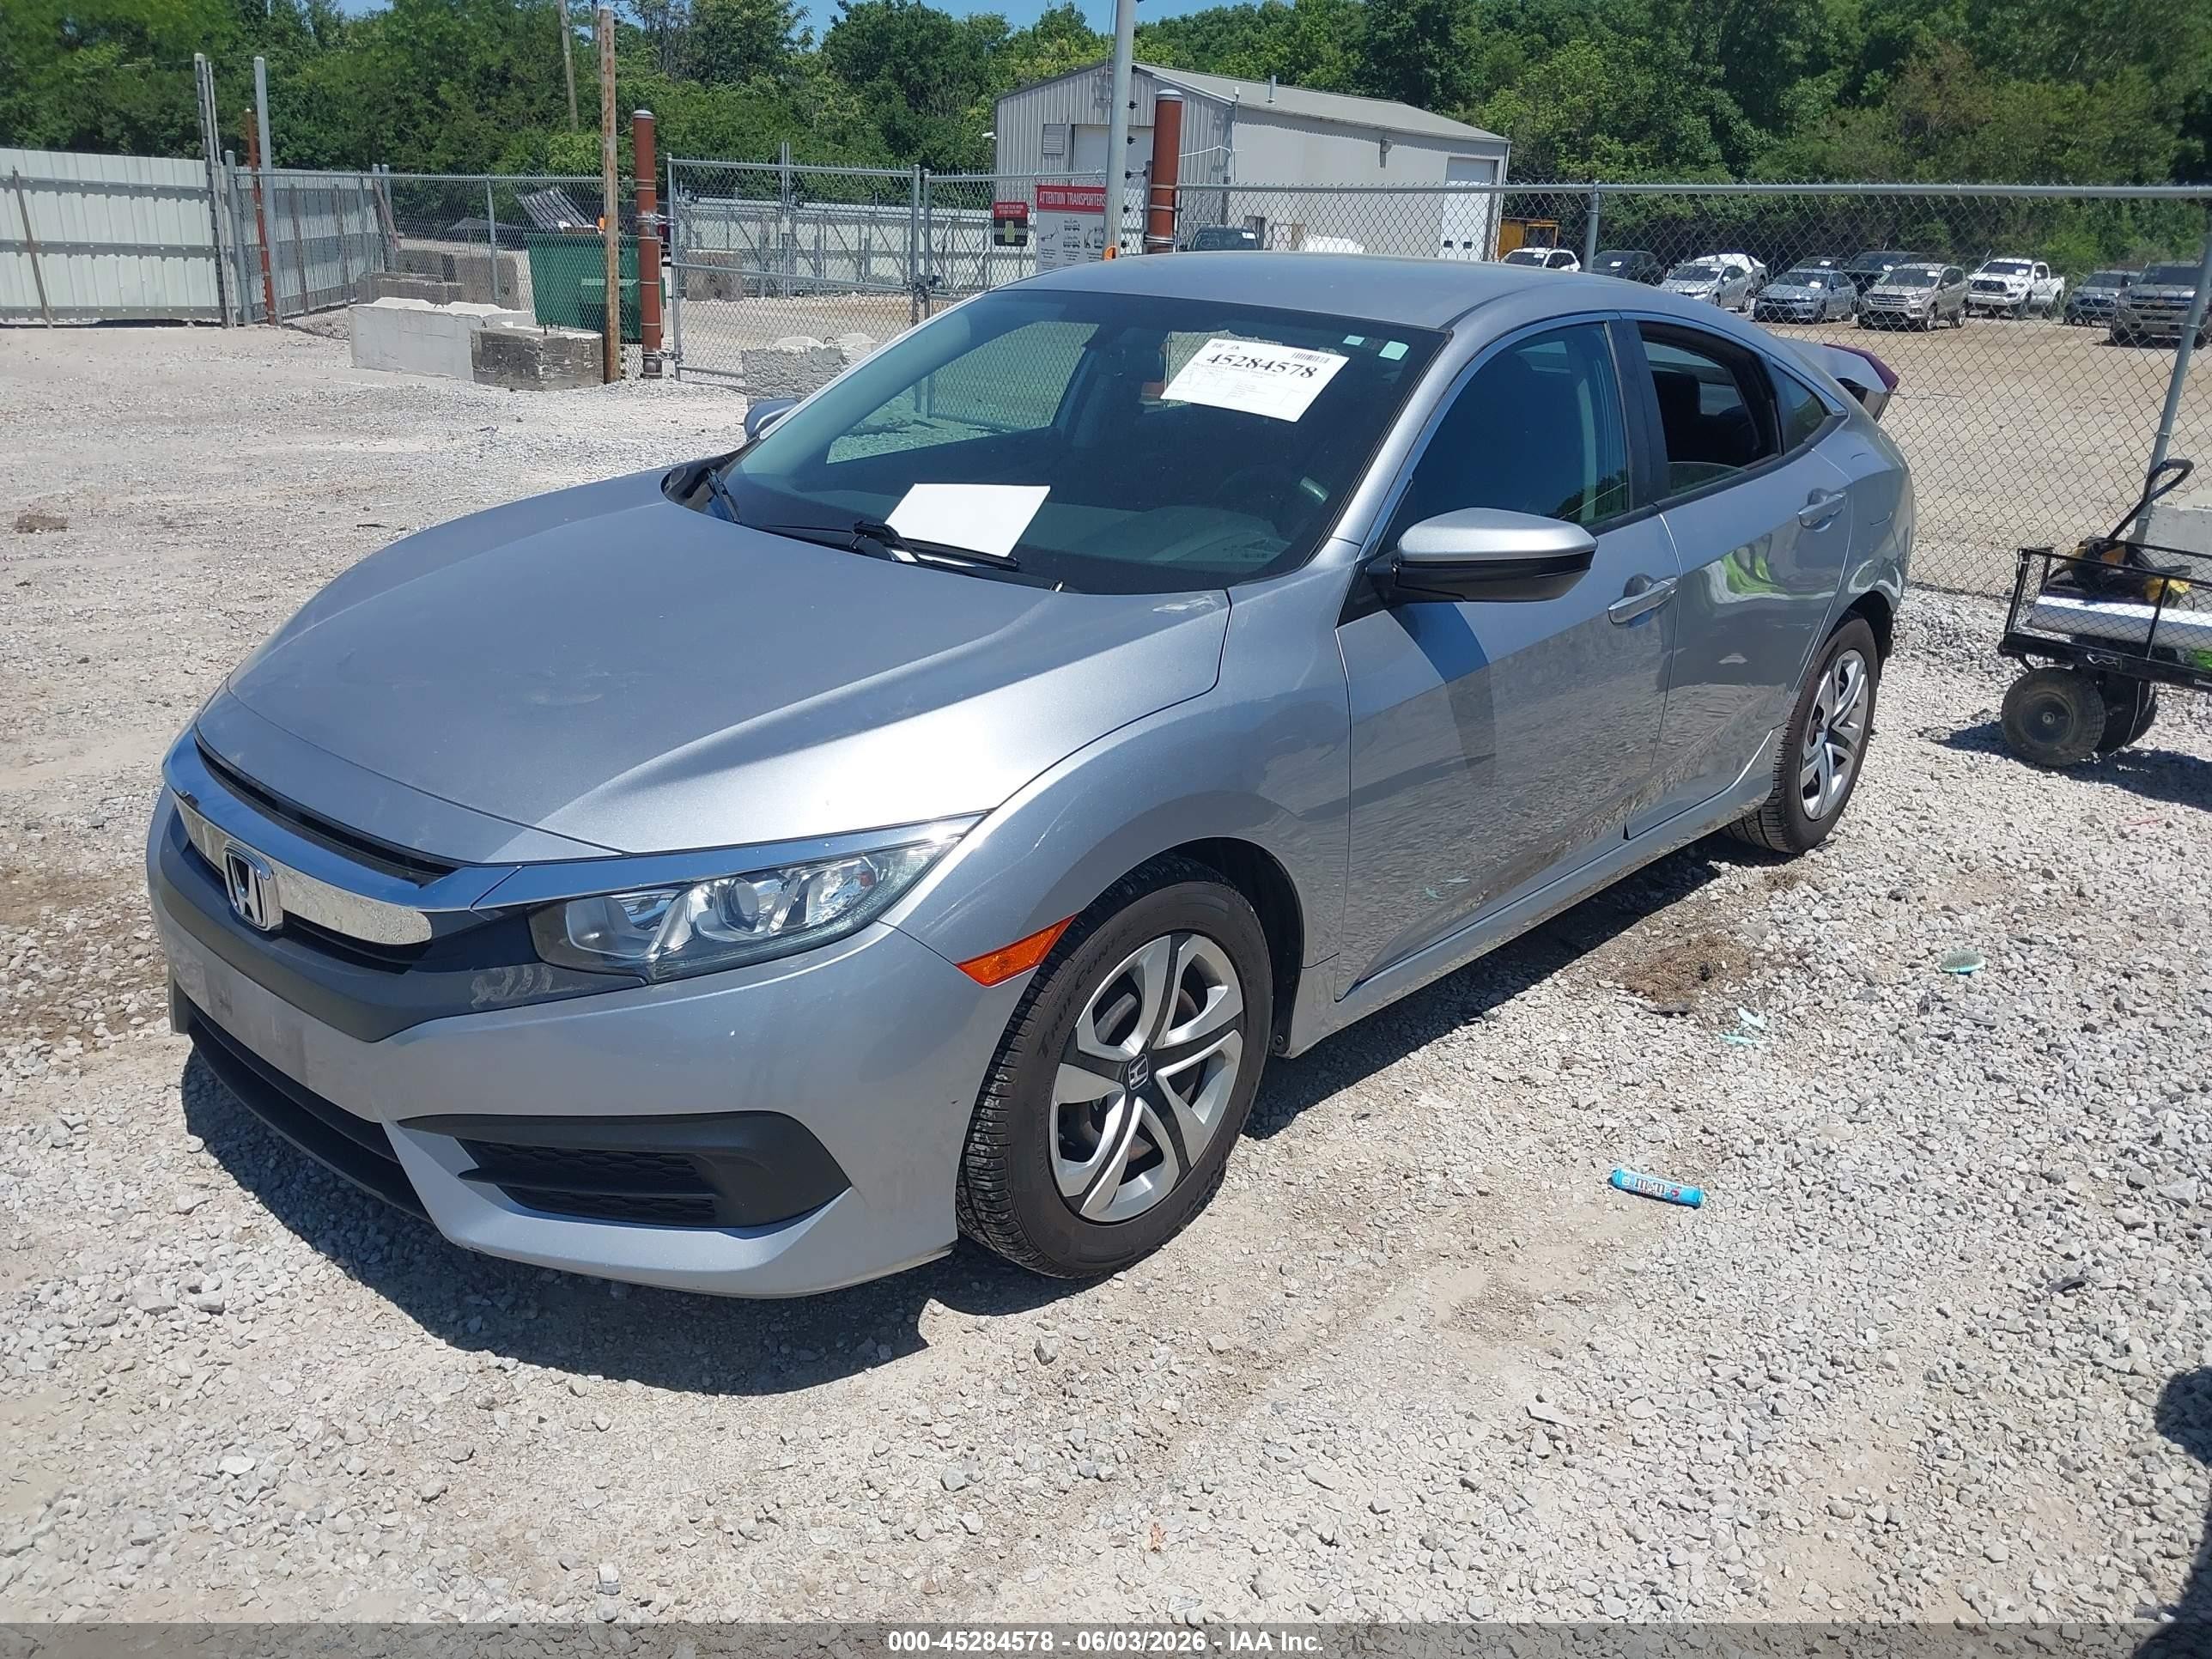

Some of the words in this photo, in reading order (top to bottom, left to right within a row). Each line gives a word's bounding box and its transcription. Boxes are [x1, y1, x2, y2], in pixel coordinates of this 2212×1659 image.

[1038, 191, 1066, 205] ATTENTION
[1066, 192, 1106, 207] TRANSPORTERS
[1206, 353, 1318, 379] 45284578
